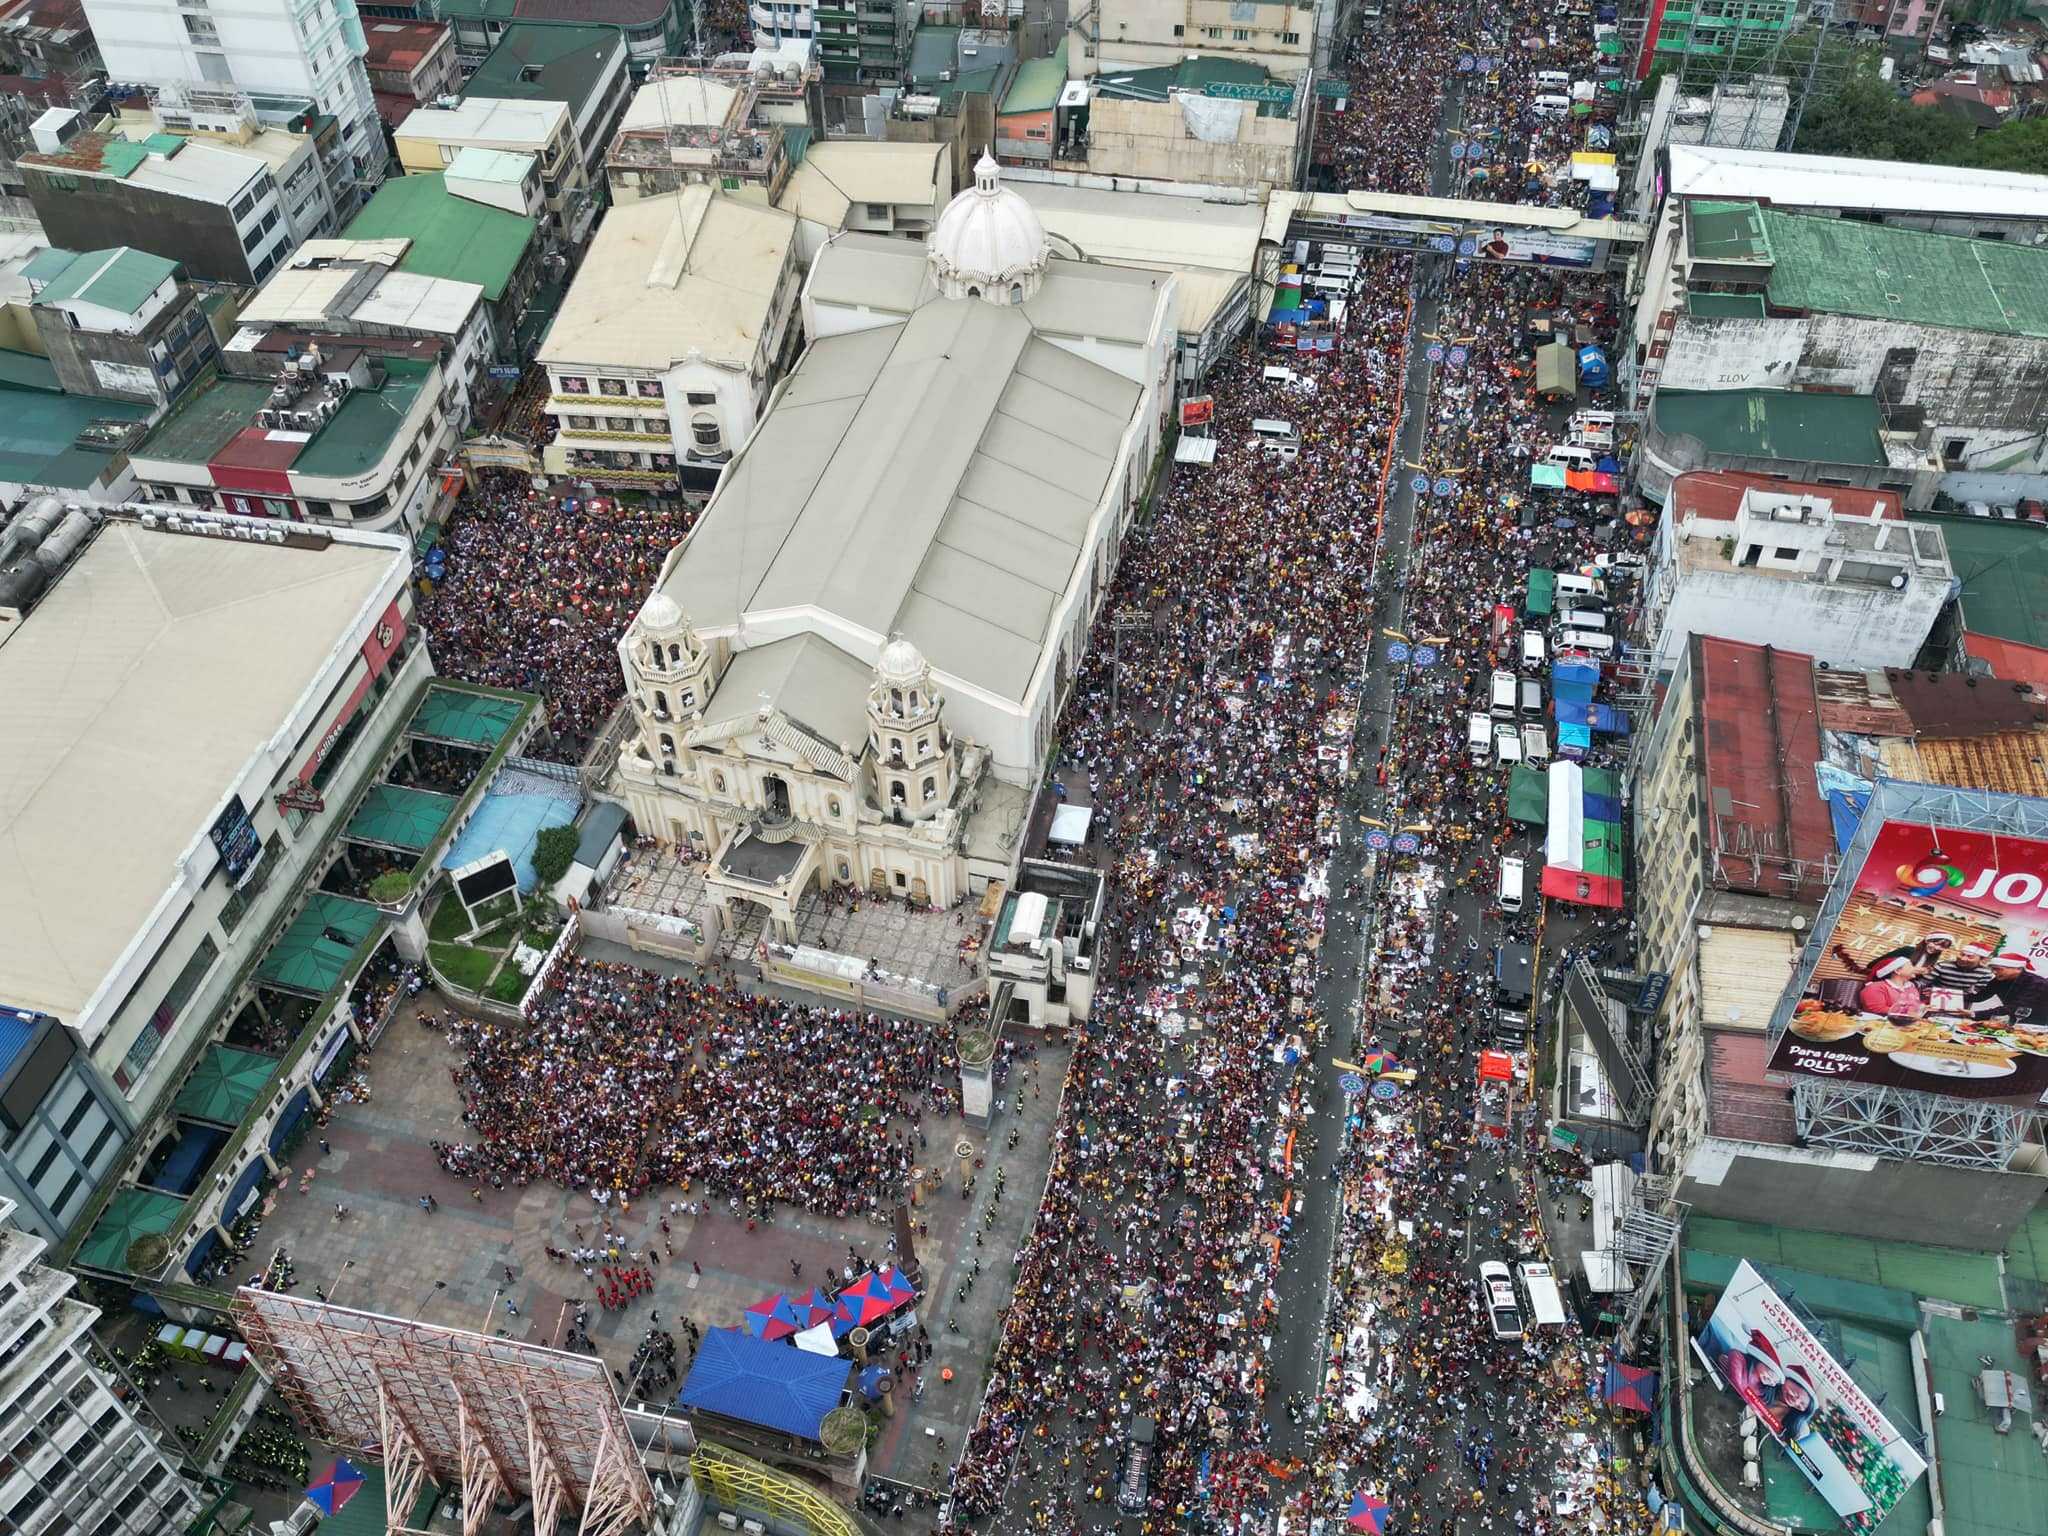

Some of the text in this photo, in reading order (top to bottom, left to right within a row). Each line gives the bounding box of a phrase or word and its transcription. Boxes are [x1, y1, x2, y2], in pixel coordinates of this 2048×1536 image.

[1209, 84, 1290, 98] CITYSTATE
[317, 724, 342, 762] Jollibee
[1789, 1045, 1870, 1065] Para laging
[1773, 1303, 1827, 1363] CELEBRATE
[1761, 1299, 1889, 1445] NO MATTER THE DISTANCE
